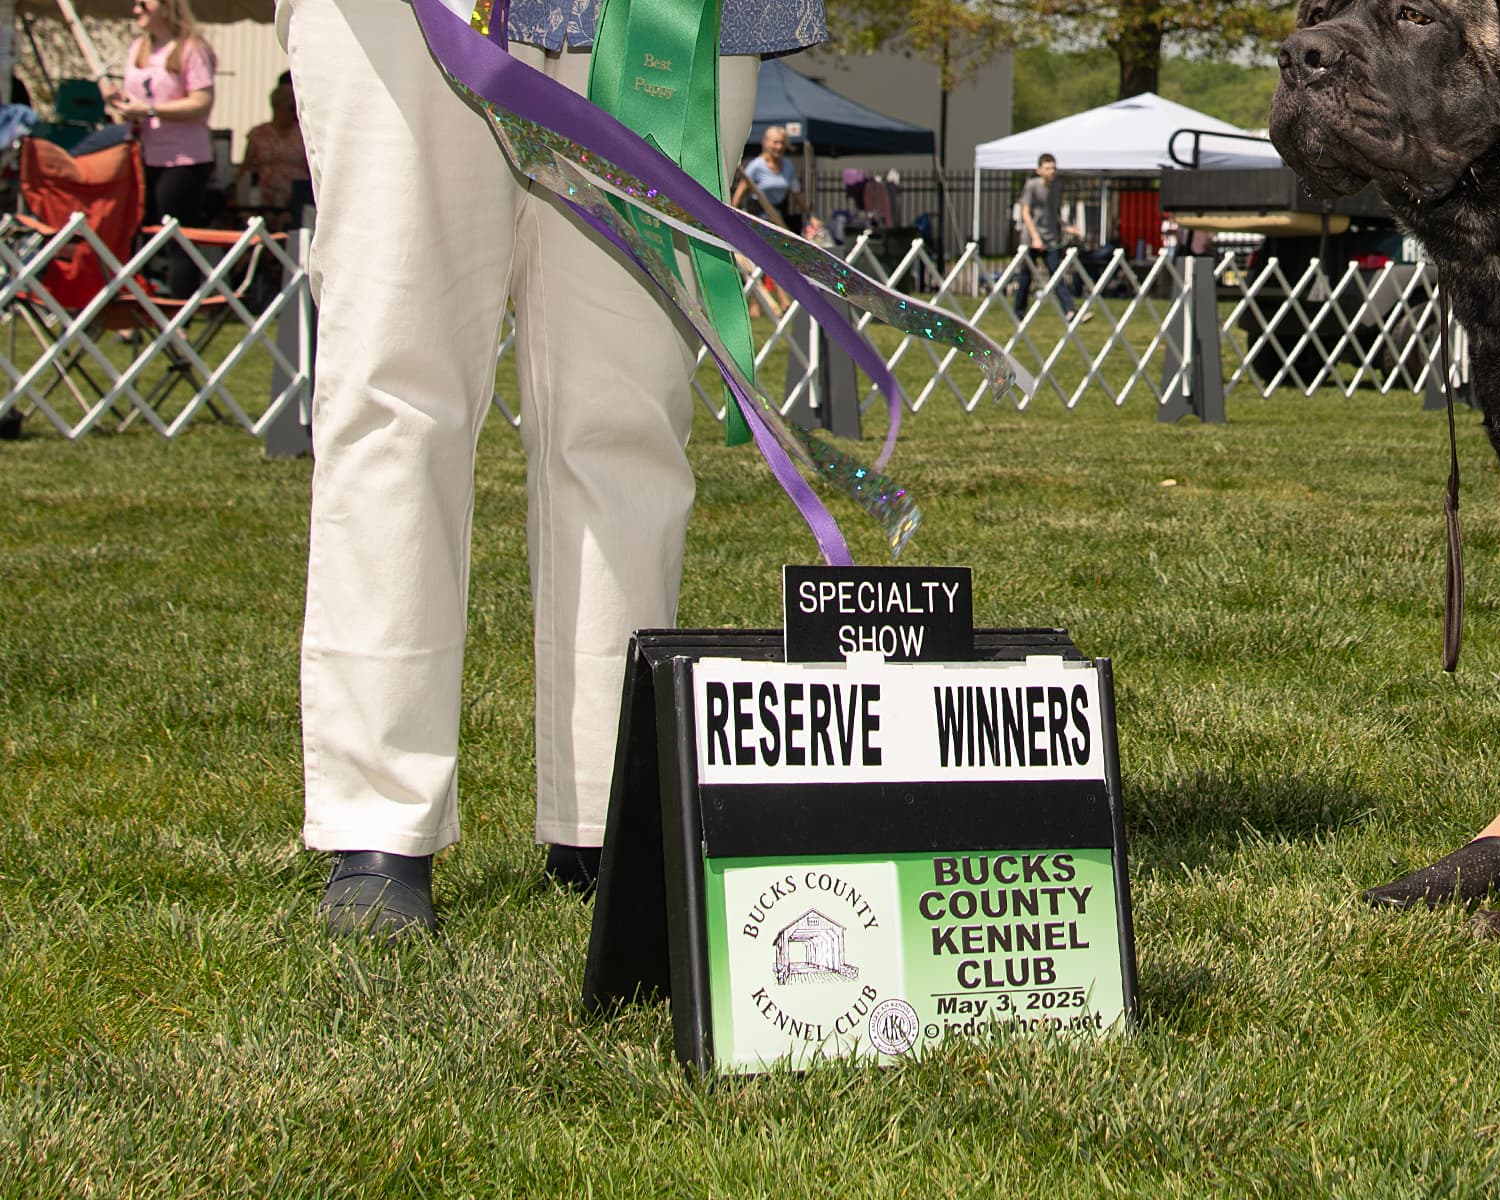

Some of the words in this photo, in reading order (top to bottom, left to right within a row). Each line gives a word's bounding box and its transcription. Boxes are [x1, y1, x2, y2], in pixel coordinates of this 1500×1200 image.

[643, 53, 672, 72] Best
[634, 76, 677, 100] Puppy
[799, 580, 960, 614] SPECIALTY
[838, 625, 925, 658] SHOW
[706, 680, 882, 766] RESERVE
[933, 683, 1092, 767] WINNERS
[932, 853, 1077, 887] BUCKS
[742, 872, 798, 940] BUCKS
[804, 871, 879, 932] COUNTY
[918, 885, 1094, 920] COUNTY
[931, 922, 1090, 955] KENNEL
[956, 956, 1058, 988] CLUB
[751, 986, 826, 1042] KENNEL
[833, 983, 878, 1036] CLUB
[936, 997, 988, 1017] May
[1025, 990, 1086, 1010] 2025
[881, 1013, 907, 1041] AKC
